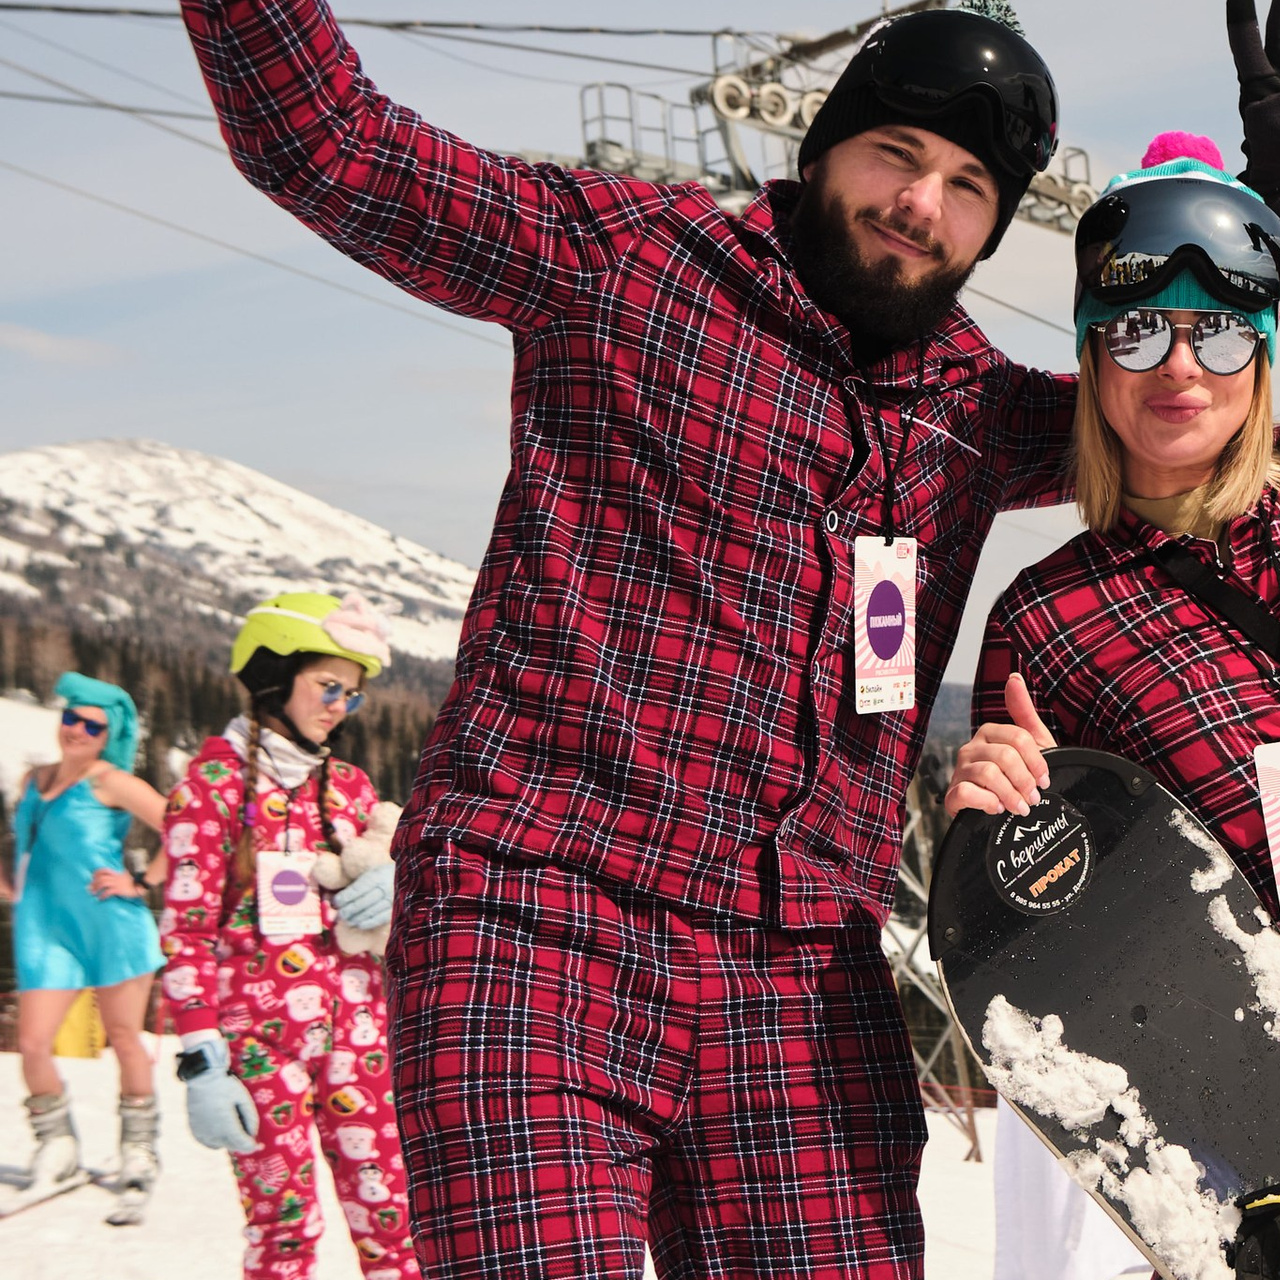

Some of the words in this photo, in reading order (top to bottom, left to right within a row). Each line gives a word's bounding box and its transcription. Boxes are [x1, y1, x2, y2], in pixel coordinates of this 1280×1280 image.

[997, 860, 1008, 883] С
[1010, 812, 1070, 869] вершины
[1029, 848, 1081, 898] ПРОКАТ
